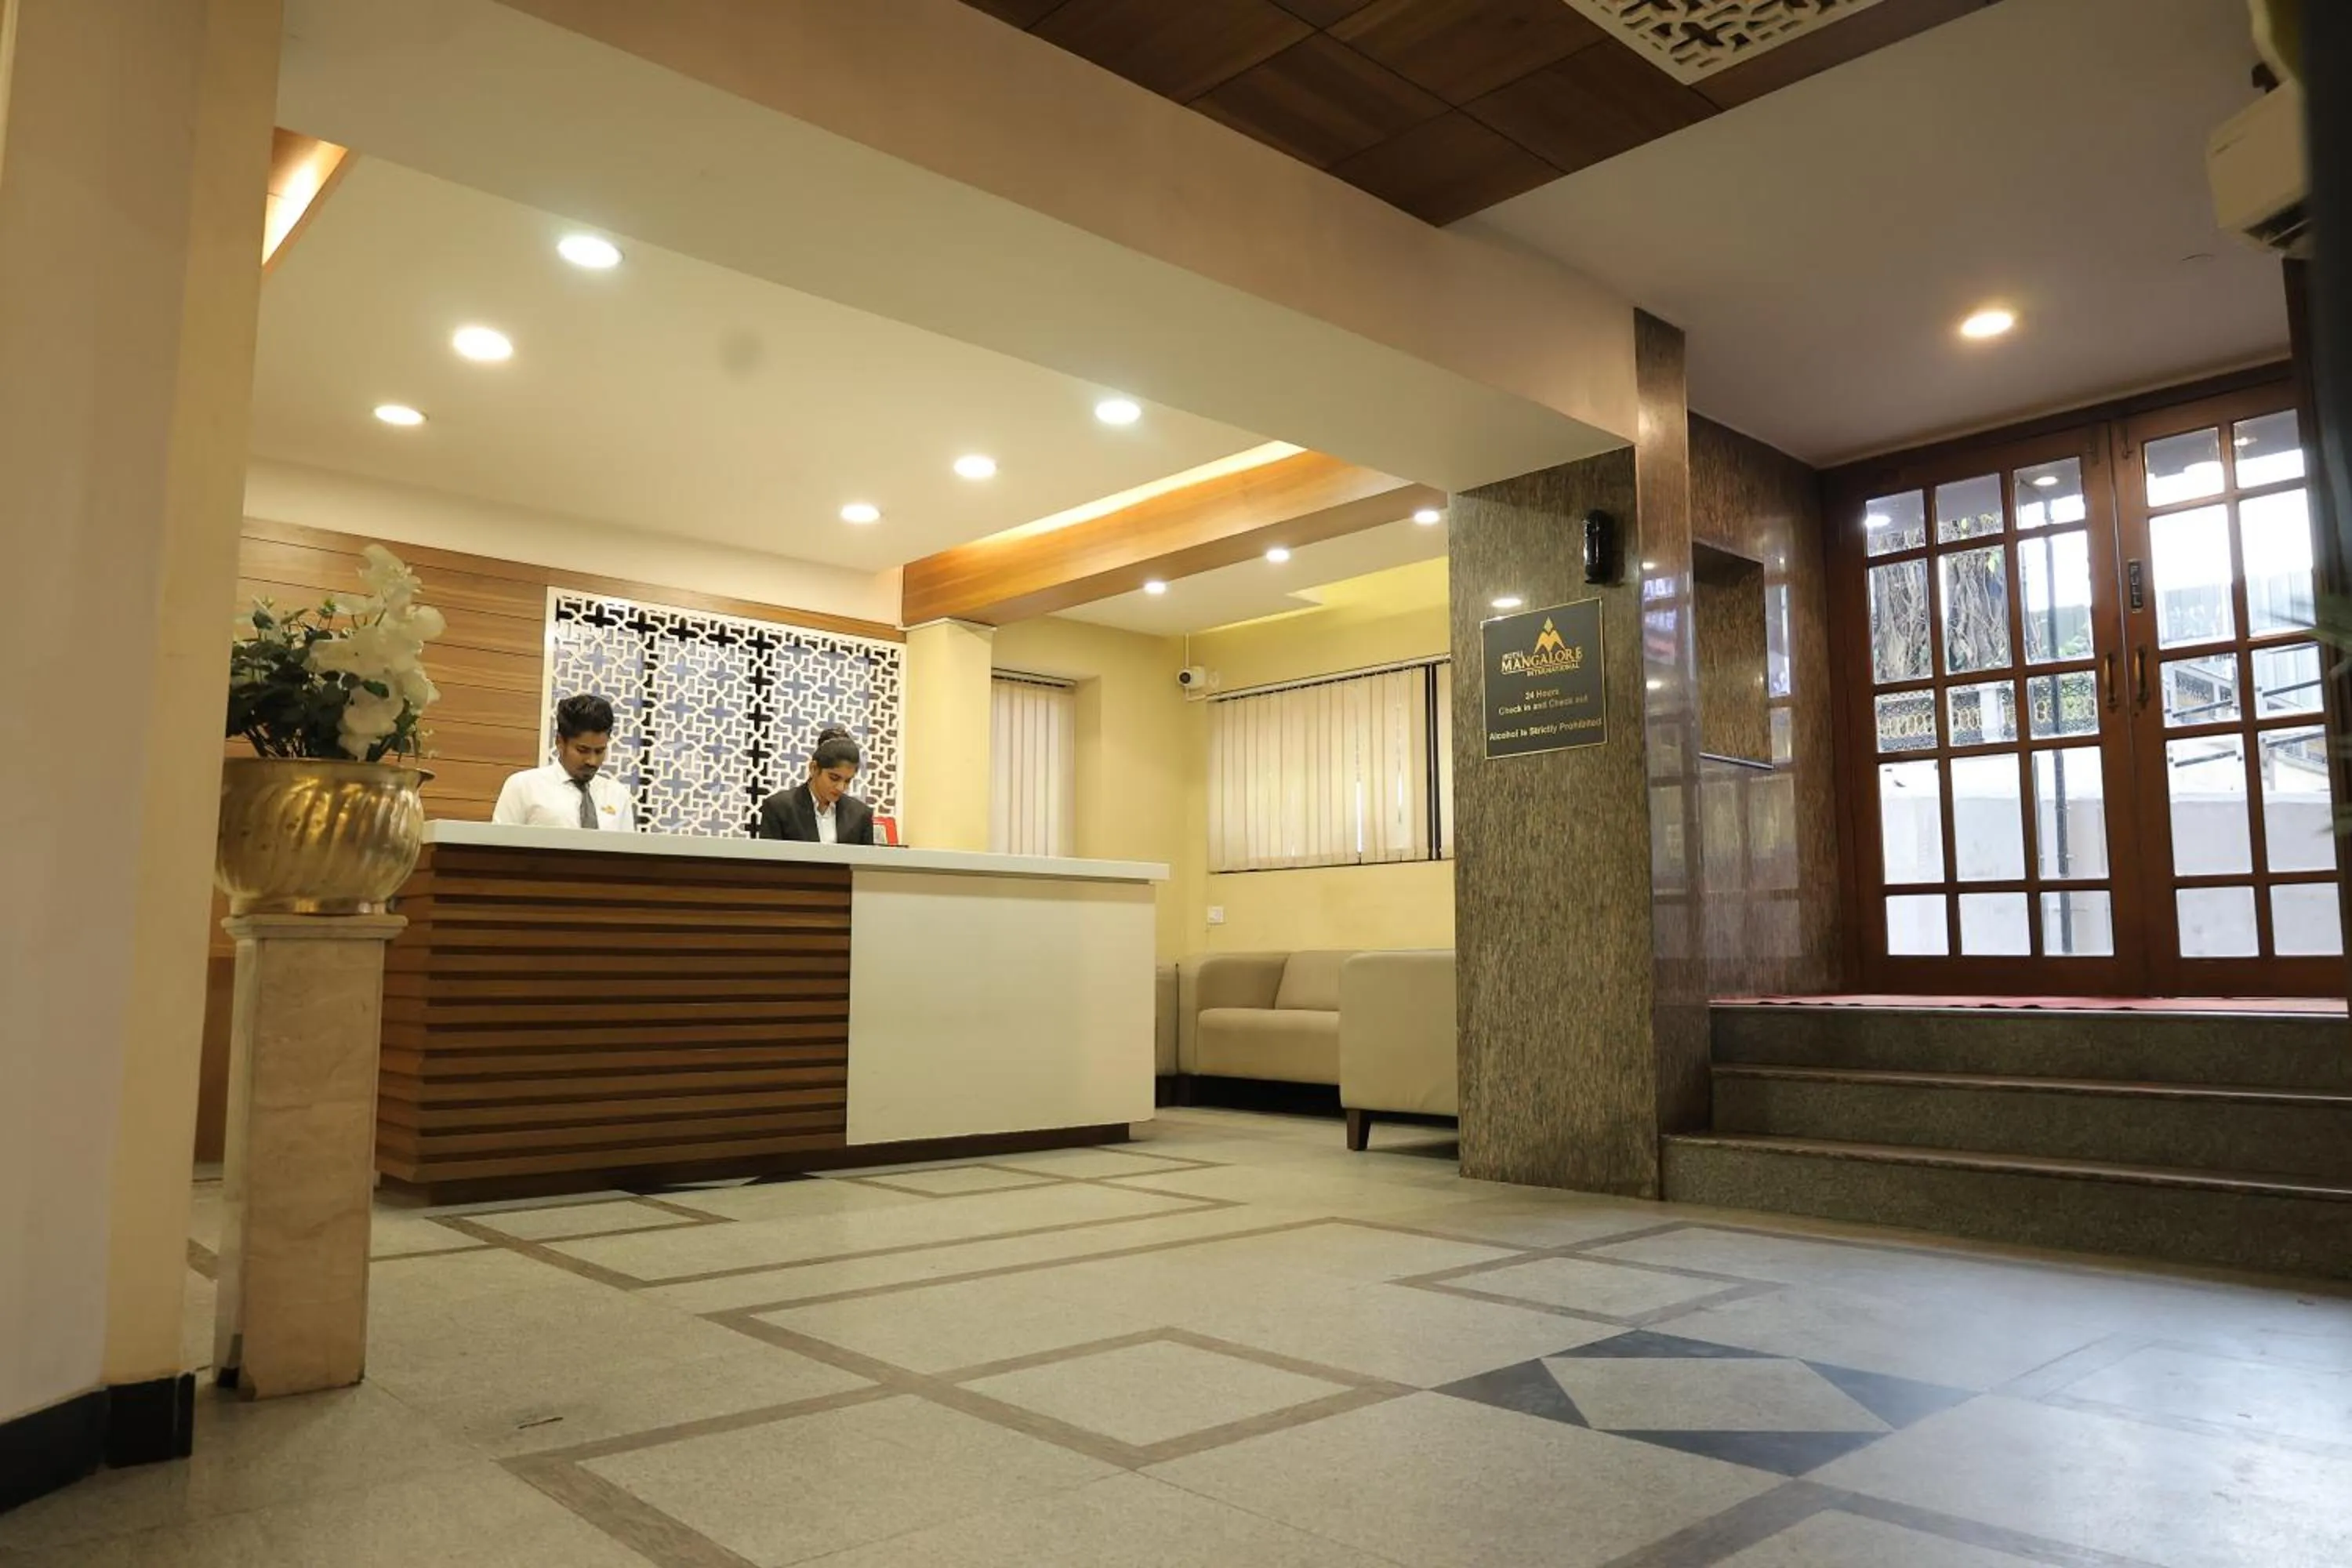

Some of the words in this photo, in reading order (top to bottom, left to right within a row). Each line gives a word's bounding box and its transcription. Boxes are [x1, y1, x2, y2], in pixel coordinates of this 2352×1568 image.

[1501, 646, 1582, 671] MANGALORE
[1525, 691, 1534, 699] 24
[1536, 688, 1559, 698] Hours
[1498, 704, 1522, 715] Check
[1533, 701, 1547, 710] and
[1548, 698, 1573, 707] Check
[1489, 729, 1518, 741] Alcohol
[1530, 725, 1558, 735] Strictly
[1559, 717, 1602, 731] Prohibited
